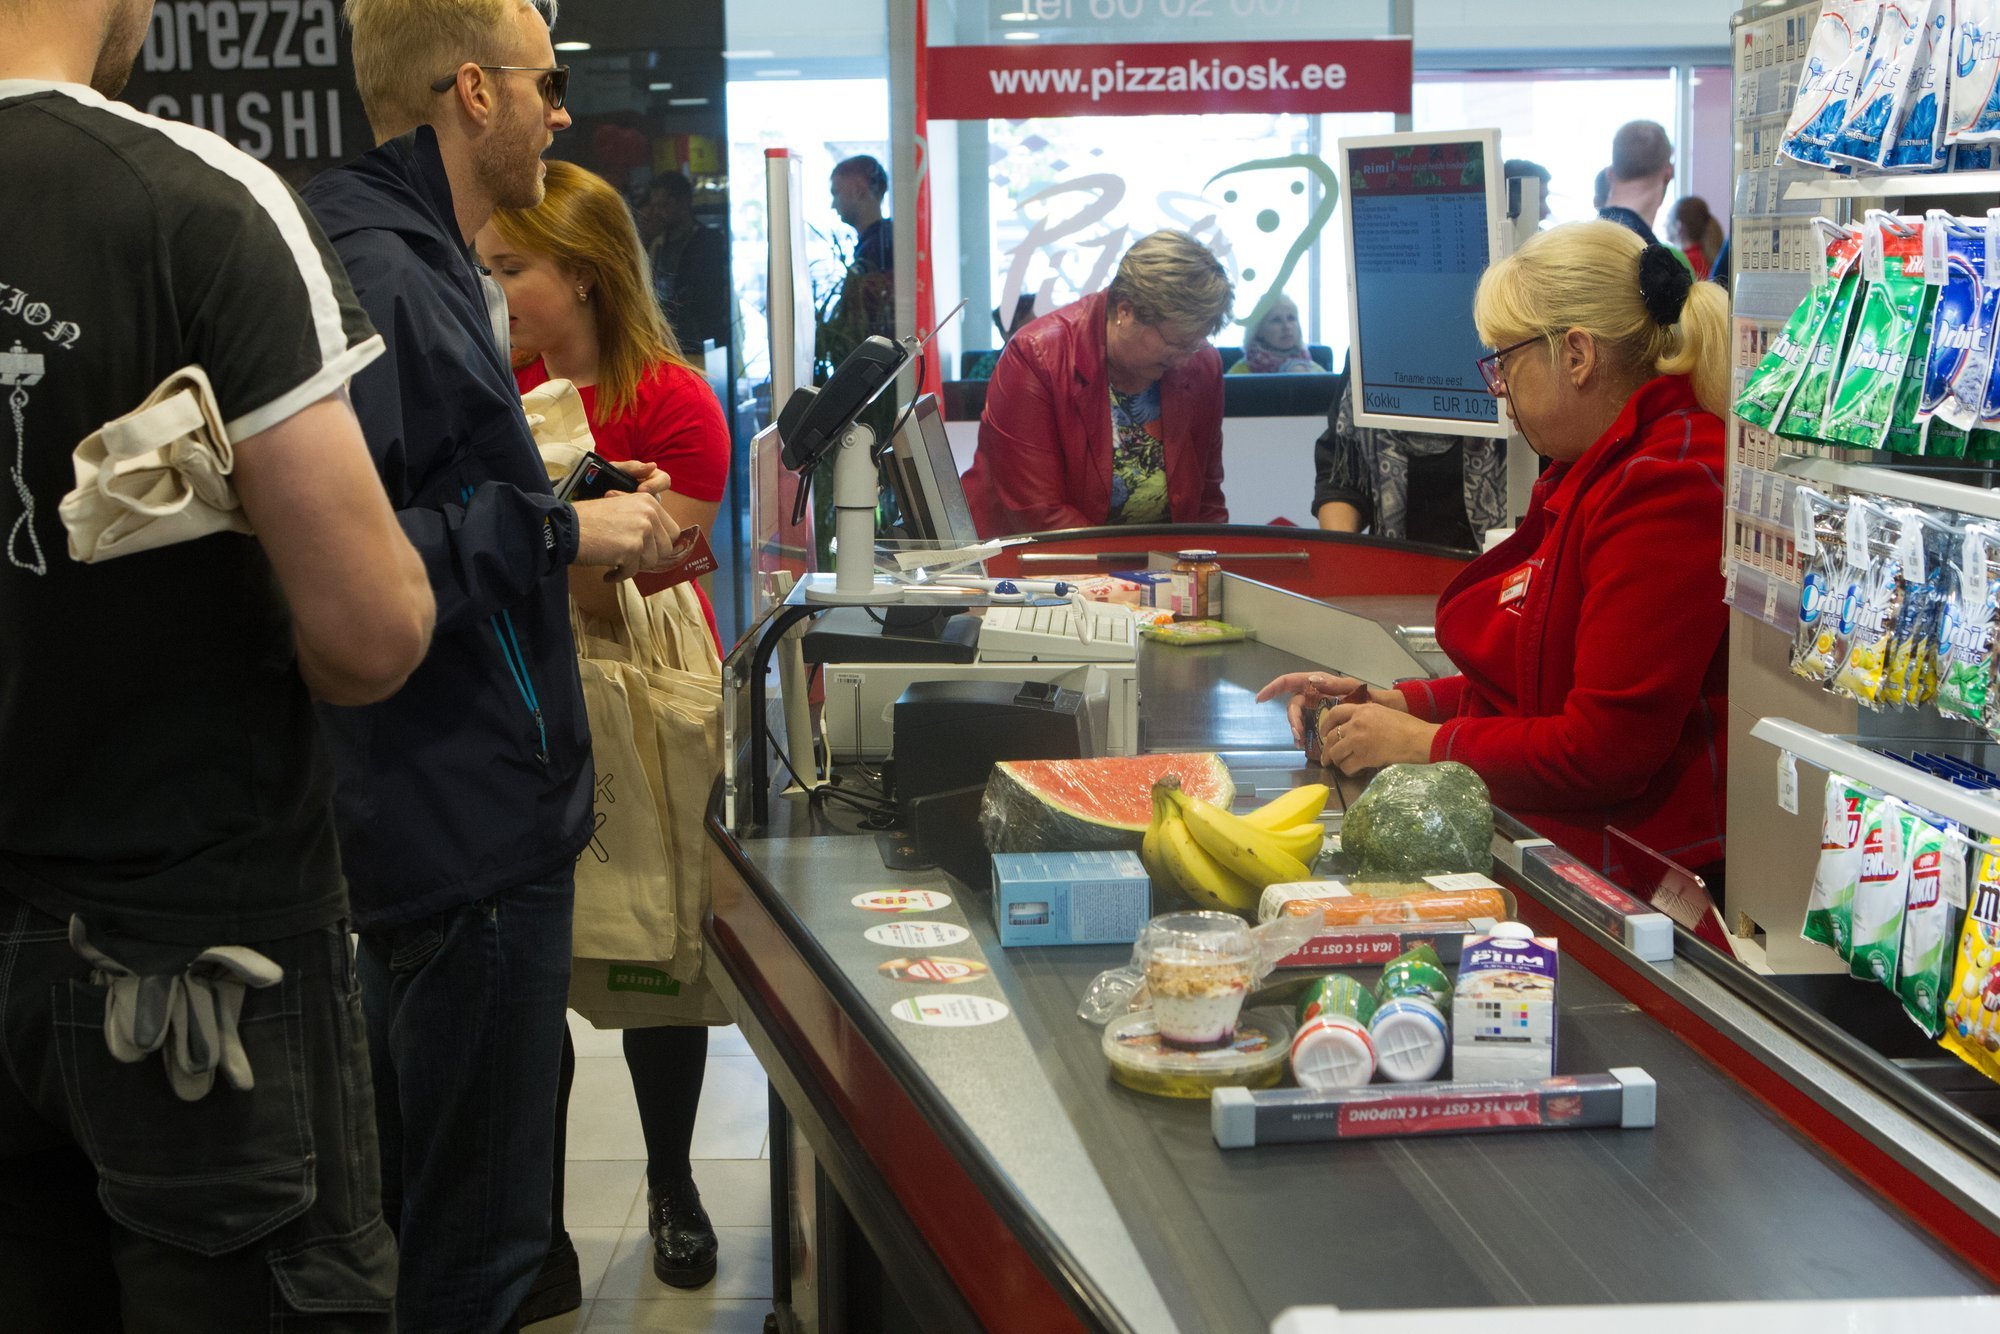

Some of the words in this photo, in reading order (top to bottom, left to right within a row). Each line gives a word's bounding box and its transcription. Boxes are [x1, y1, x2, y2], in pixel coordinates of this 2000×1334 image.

[988, 57, 1347, 102] www.pizzakiosk.ee
[1394, 371, 1425, 385] Täname
[1426, 376, 1444, 385] ostu
[1445, 377, 1463, 387] eest
[1366, 392, 1400, 409] Kokku
[1433, 395, 1461, 412] EUR
[1464, 398, 1498, 416] 10,75
[1321, 944, 1344, 956] OST
[1345, 944, 1353, 954] €
[1356, 943, 1369, 954] 15
[1372, 941, 1392, 953] IGA
[1470, 952, 1545, 968] PIIM
[1409, 1106, 1419, 1117] €
[1421, 1106, 1429, 1116] 1
[1442, 1103, 1470, 1116] OST
[1471, 1102, 1481, 1114] €
[1484, 1101, 1500, 1113] 15
[1504, 1101, 1529, 1112] IGA
[1349, 1107, 1407, 1122] KUPONG
